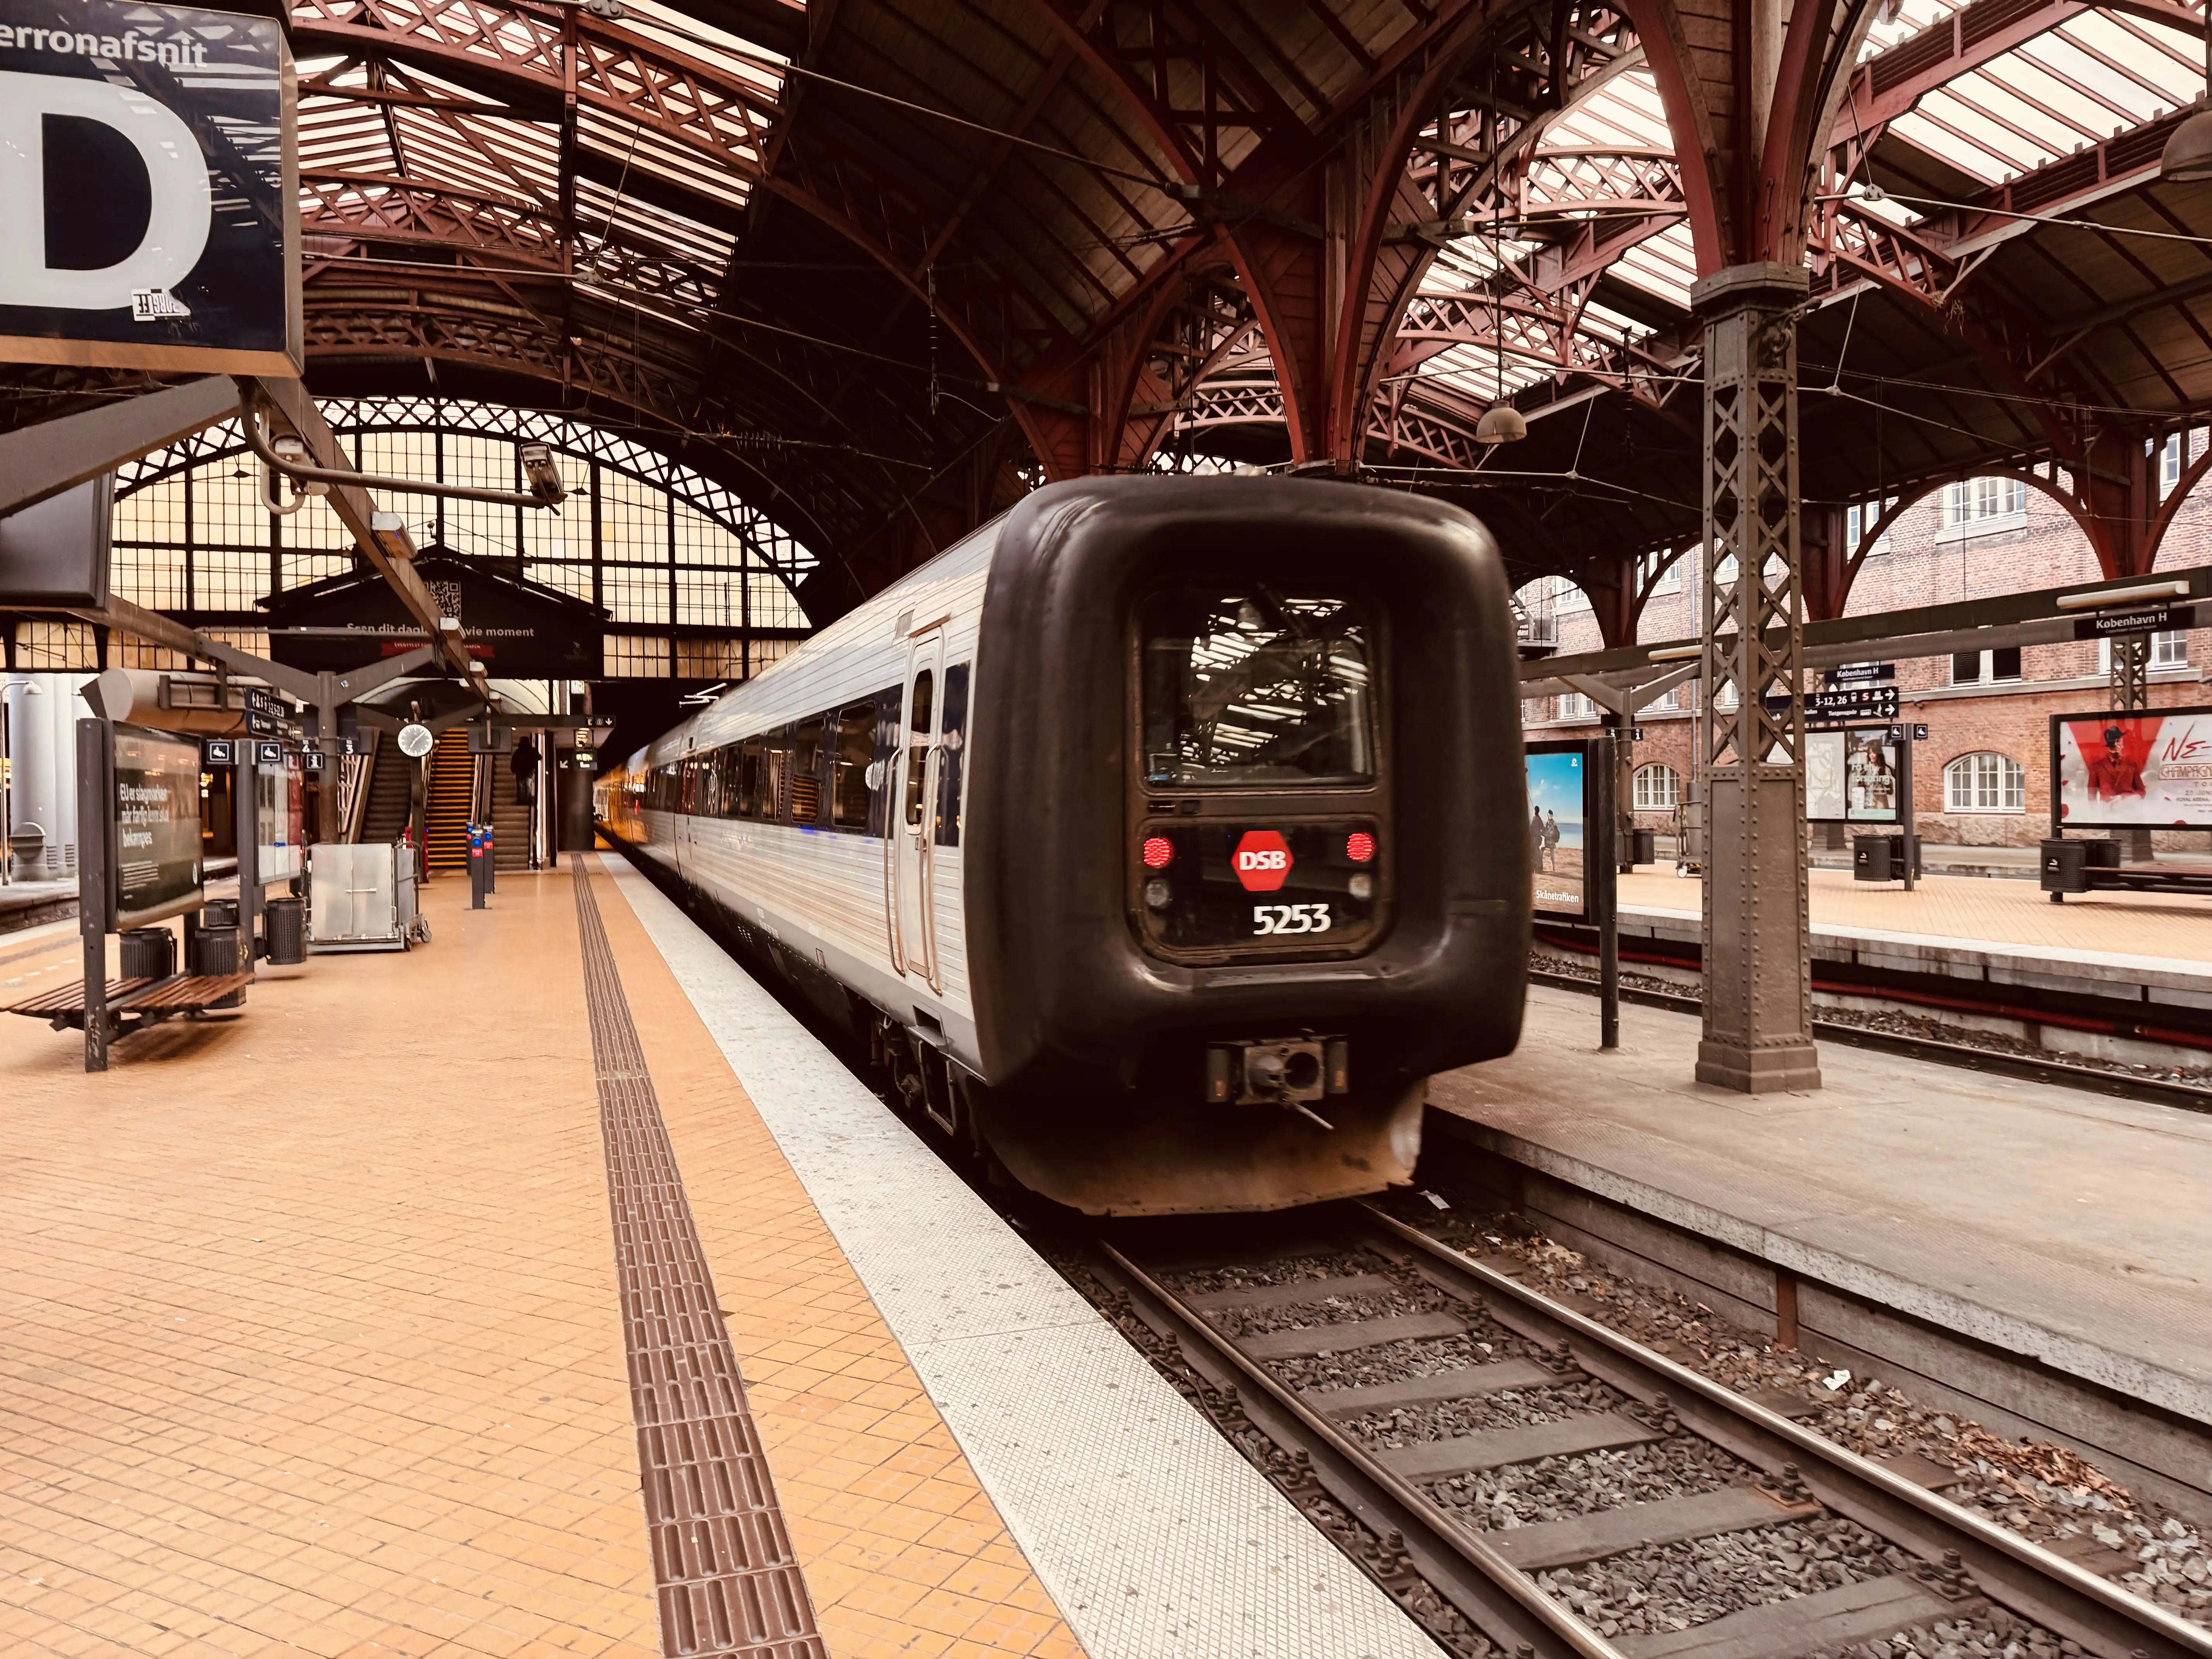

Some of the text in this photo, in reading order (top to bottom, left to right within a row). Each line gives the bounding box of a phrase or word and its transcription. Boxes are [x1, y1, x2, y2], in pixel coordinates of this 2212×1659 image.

[0, 24, 207, 68] erronafsnit
[0, 70, 211, 310] D
[2096, 612, 2167, 629] København H
[378, 623, 395, 633] dit
[486, 627, 534, 637] moment
[1837, 669, 1872, 678] København
[1815, 697, 1836, 707] 3-12,
[1837, 696, 1847, 704] 26
[302, 744, 310, 753] 4
[346, 744, 354, 754] 3
[120, 783, 129, 801] EU
[1239, 850, 1287, 870] DSB
[1536, 890, 1579, 903] Skånetrafiken
[1253, 903, 1331, 935] 5253
